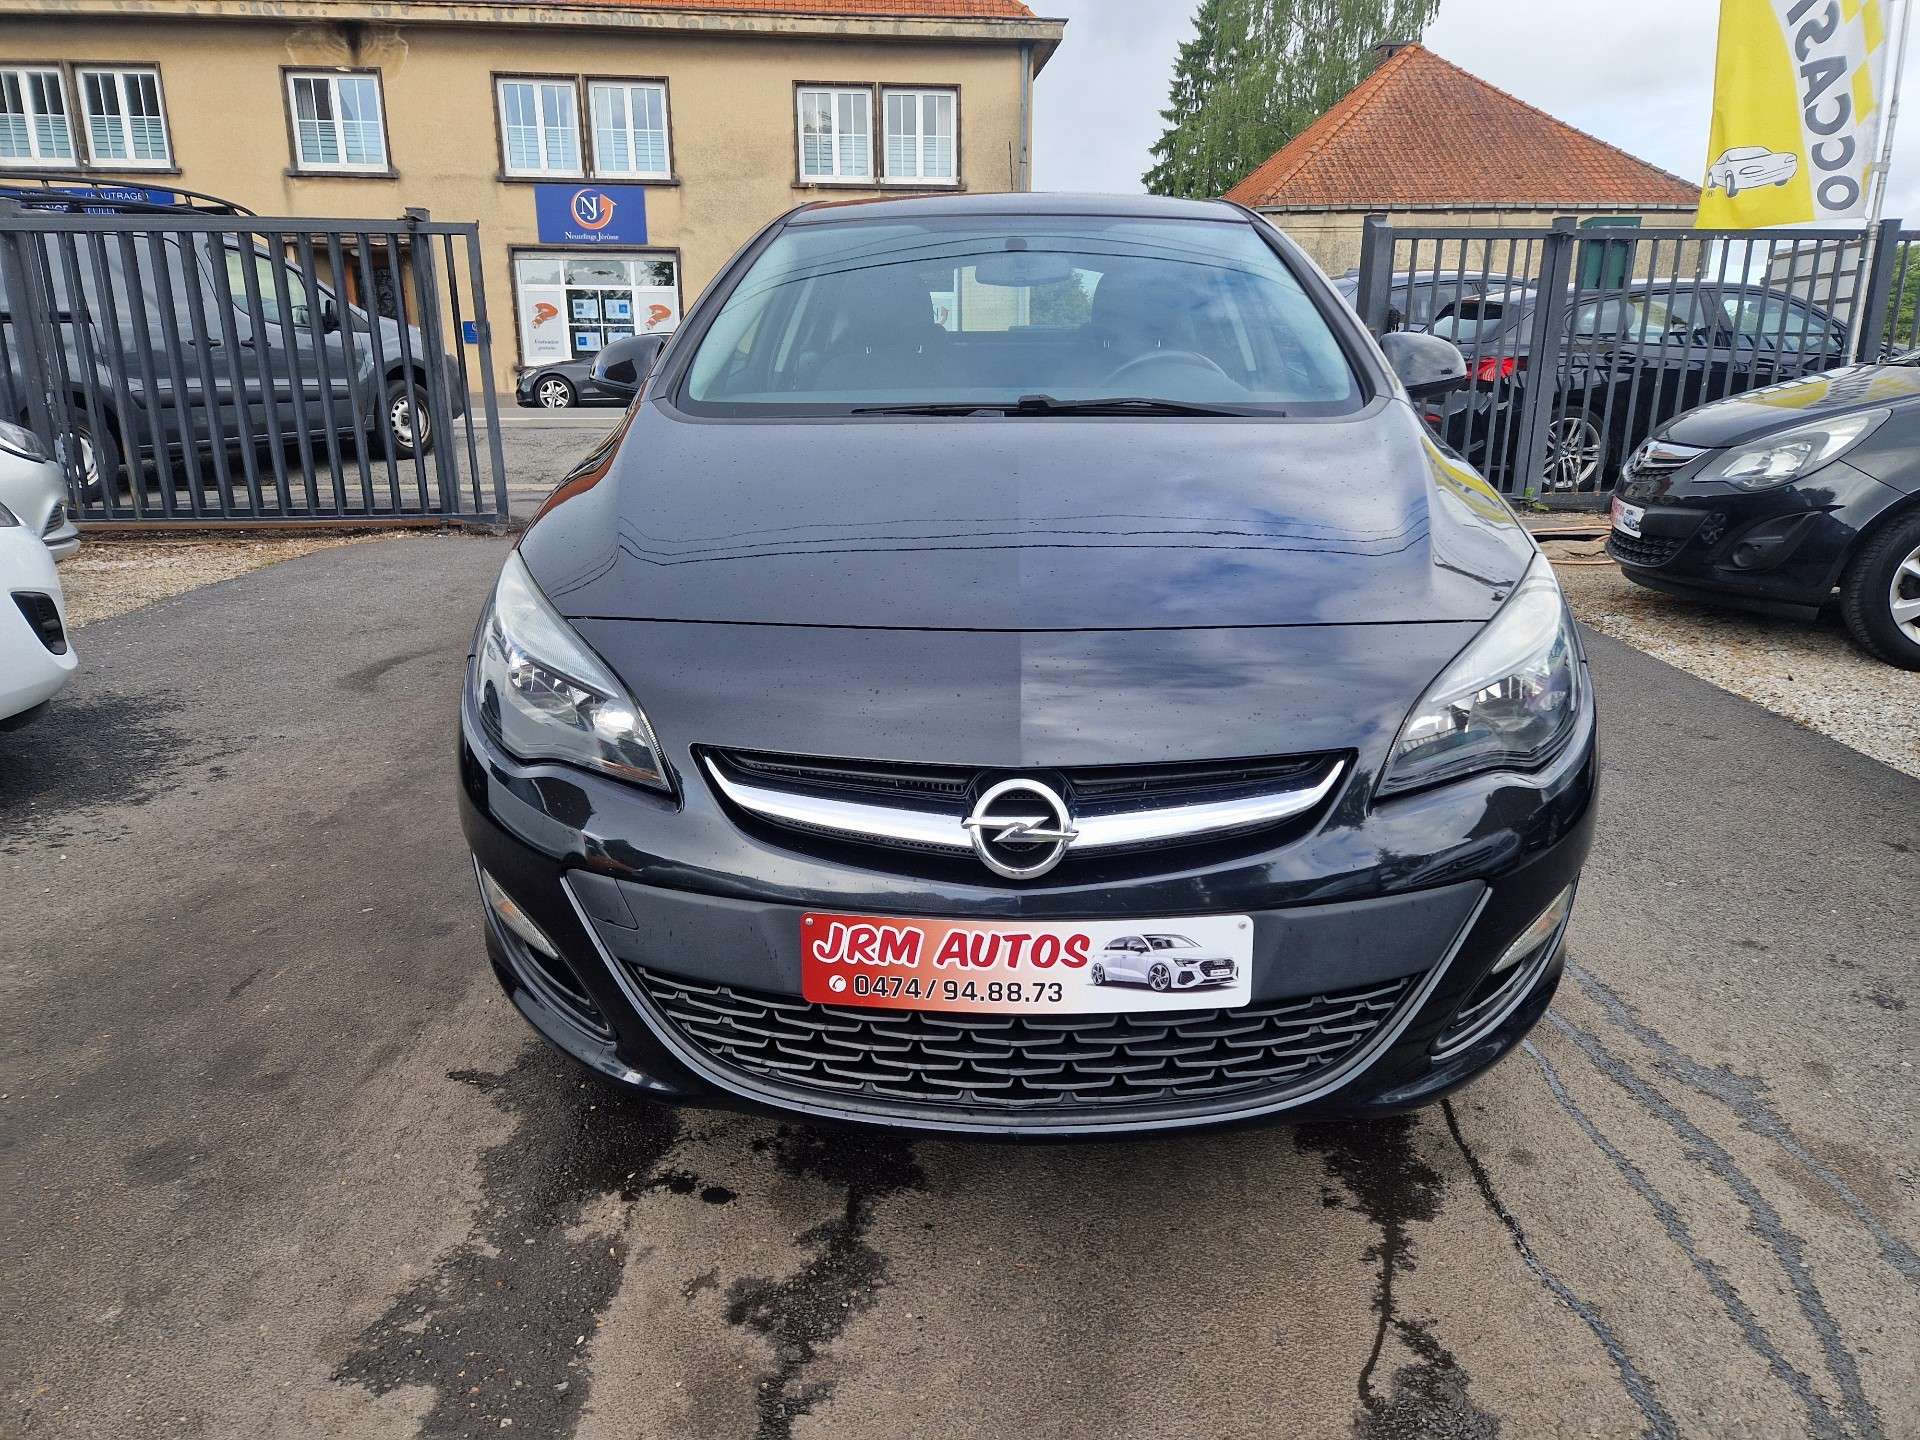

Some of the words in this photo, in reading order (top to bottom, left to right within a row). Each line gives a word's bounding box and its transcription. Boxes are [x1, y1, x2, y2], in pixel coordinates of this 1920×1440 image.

[579, 196, 598, 220] NJ
[814, 923, 924, 967] JRM
[934, 929, 1091, 970] AUTOS
